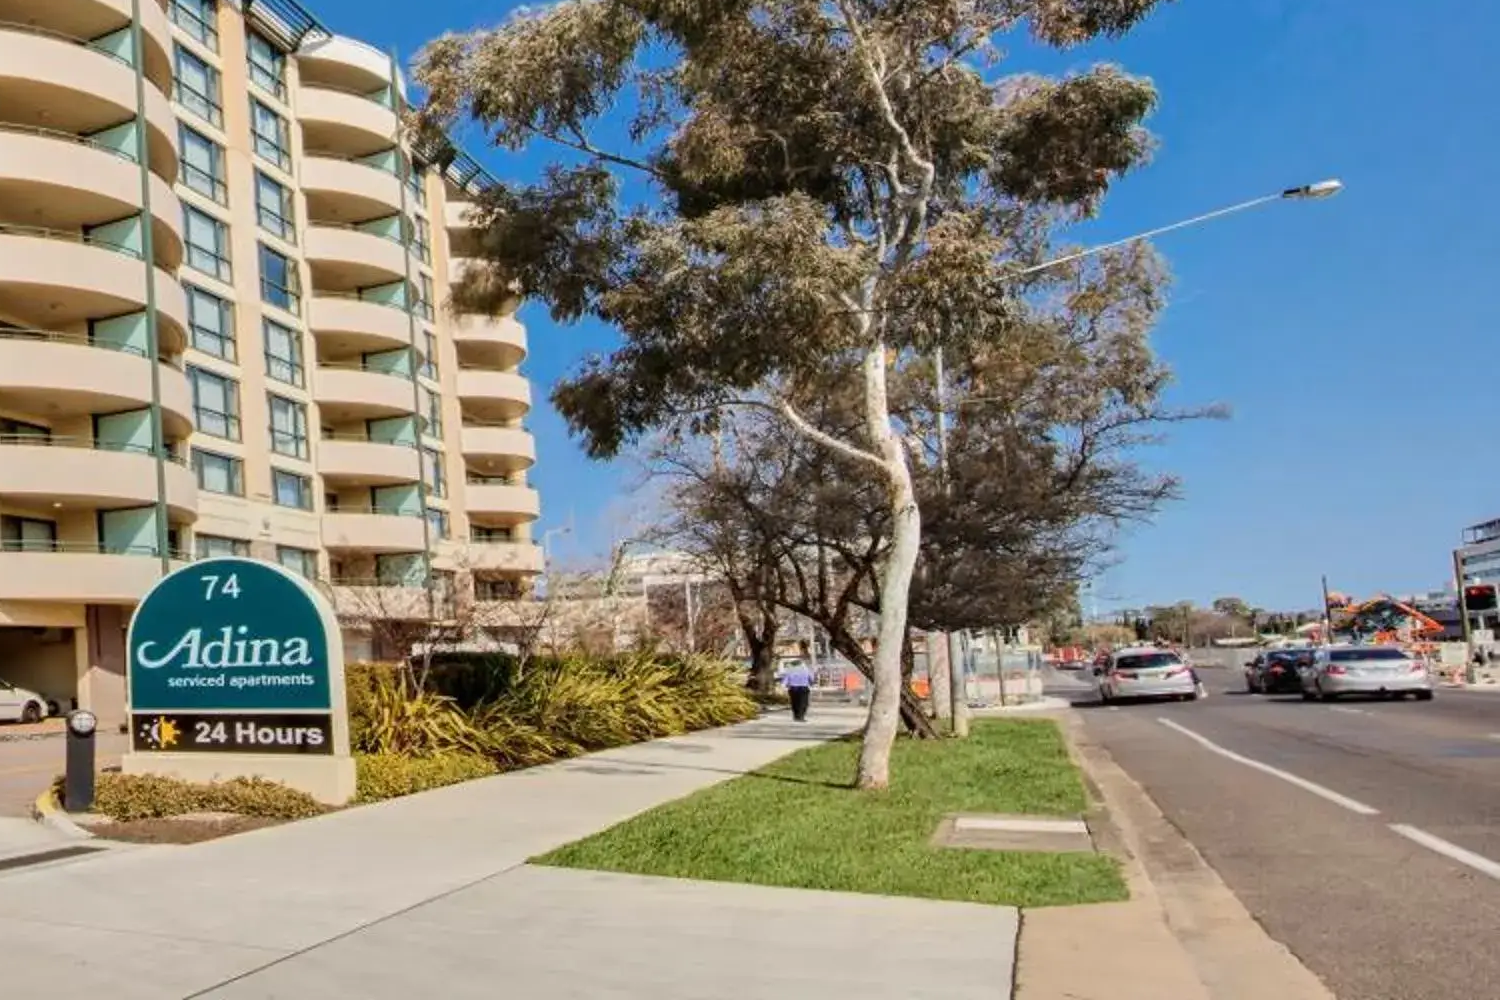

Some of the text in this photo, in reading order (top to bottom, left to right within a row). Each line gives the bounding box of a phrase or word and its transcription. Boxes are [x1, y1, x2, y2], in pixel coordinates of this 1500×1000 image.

[200, 573, 241, 600] 74
[137, 625, 313, 668] Adina
[167, 672, 315, 689] serviced apartments
[194, 721, 324, 745] 24 Hours
